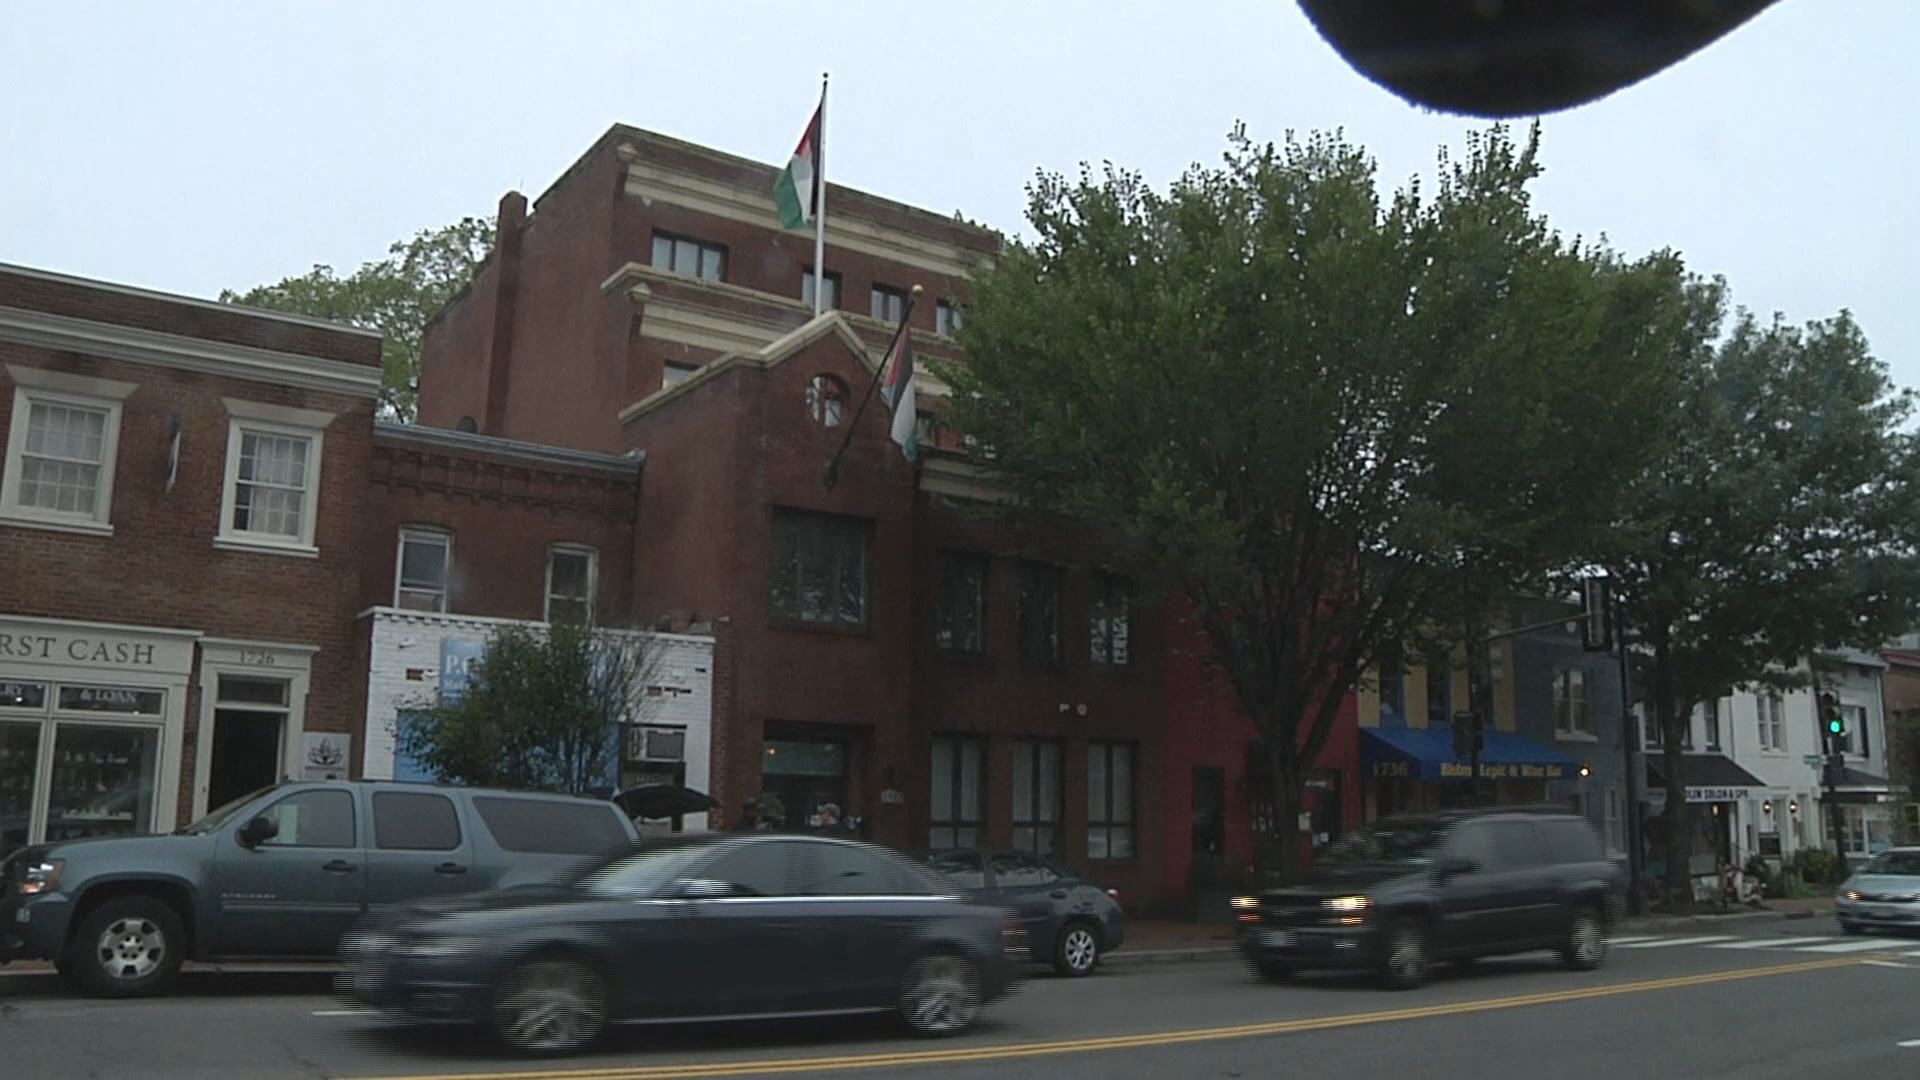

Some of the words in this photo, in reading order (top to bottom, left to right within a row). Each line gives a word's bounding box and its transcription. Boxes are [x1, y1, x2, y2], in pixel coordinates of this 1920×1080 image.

[0, 634, 56, 658] RST
[68, 639, 155, 664] CASH
[239, 649, 274, 664] 1726
[80, 688, 92, 702] &
[95, 689, 137, 704] LOAN
[1508, 764, 1518, 777] &
